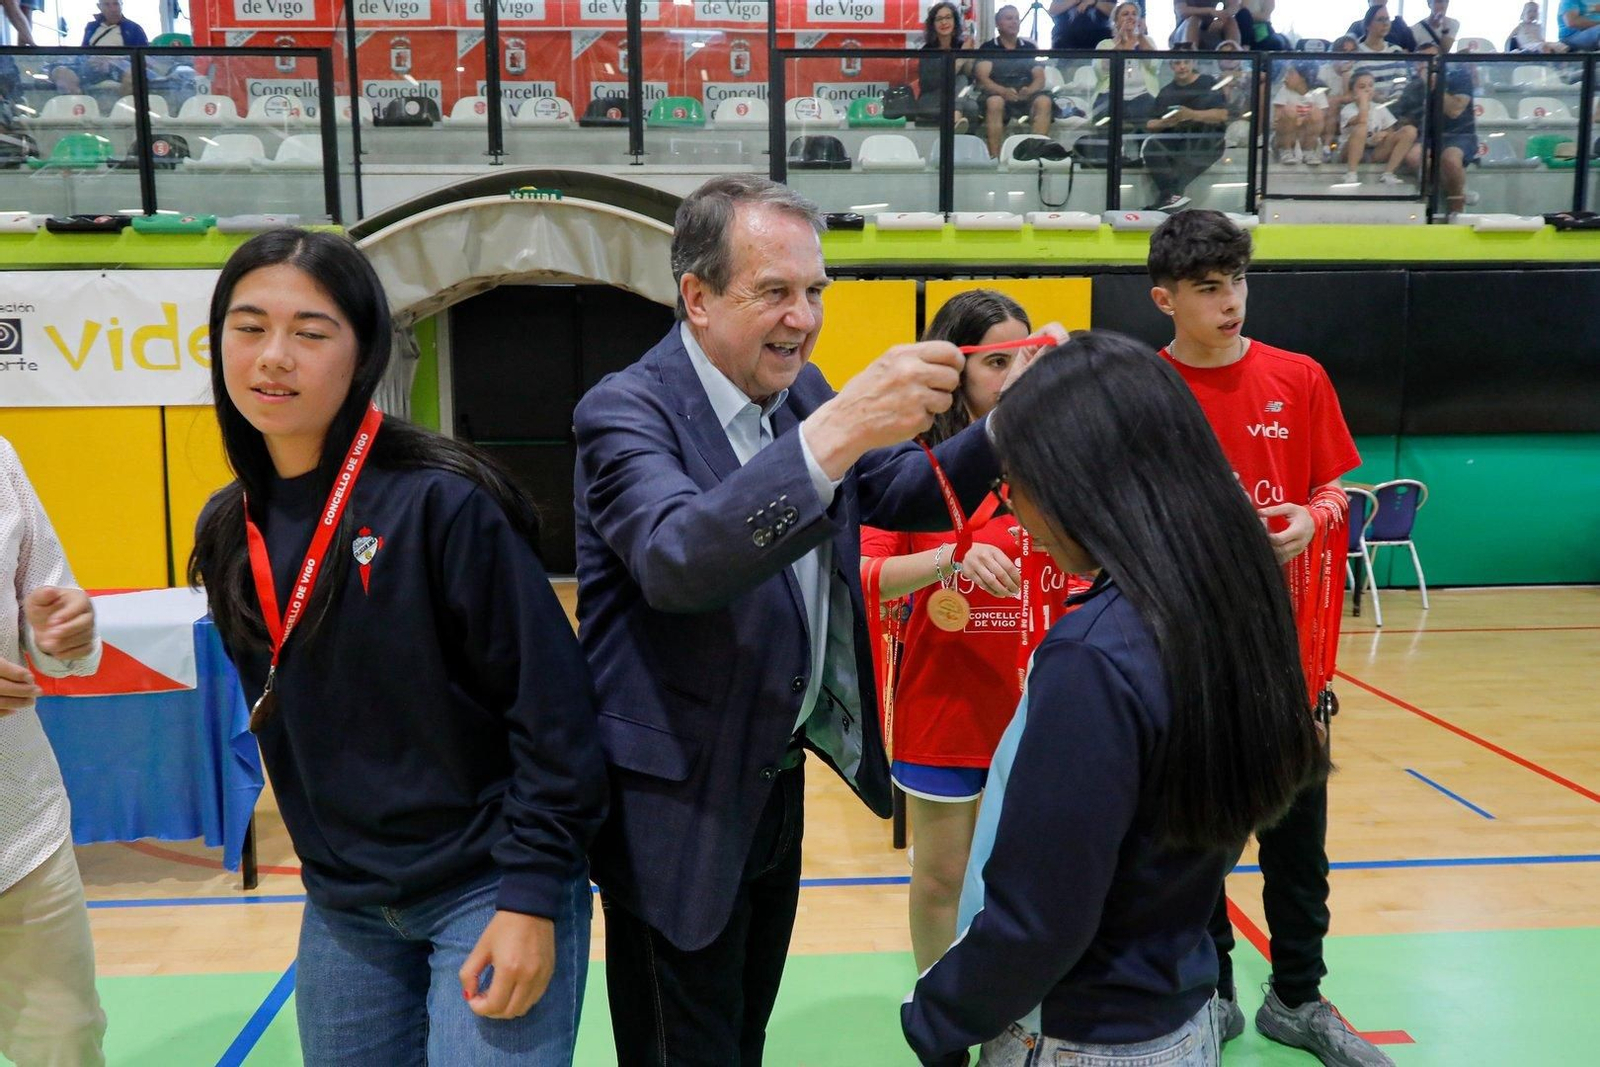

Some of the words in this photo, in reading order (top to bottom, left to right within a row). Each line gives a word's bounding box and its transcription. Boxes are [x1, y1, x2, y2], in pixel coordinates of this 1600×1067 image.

[243, 0, 261, 14] de
[267, 0, 303, 18] Vigo
[359, 0, 378, 14] de
[384, 0, 419, 18] Vigo
[588, 0, 607, 14] de
[703, 0, 721, 15] de
[727, 1, 760, 20] Vigo
[815, 2, 833, 16] de
[839, 2, 873, 21] Vigo
[366, 83, 438, 99] Concello
[706, 85, 770, 100] Concell
[1246, 420, 1289, 440] vide
[324, 470, 351, 526] CONCELLO
[348, 456, 358, 472] DE
[353, 433, 369, 456] VIGO
[301, 558, 315, 585] VIGO
[298, 584, 307, 601] DE
